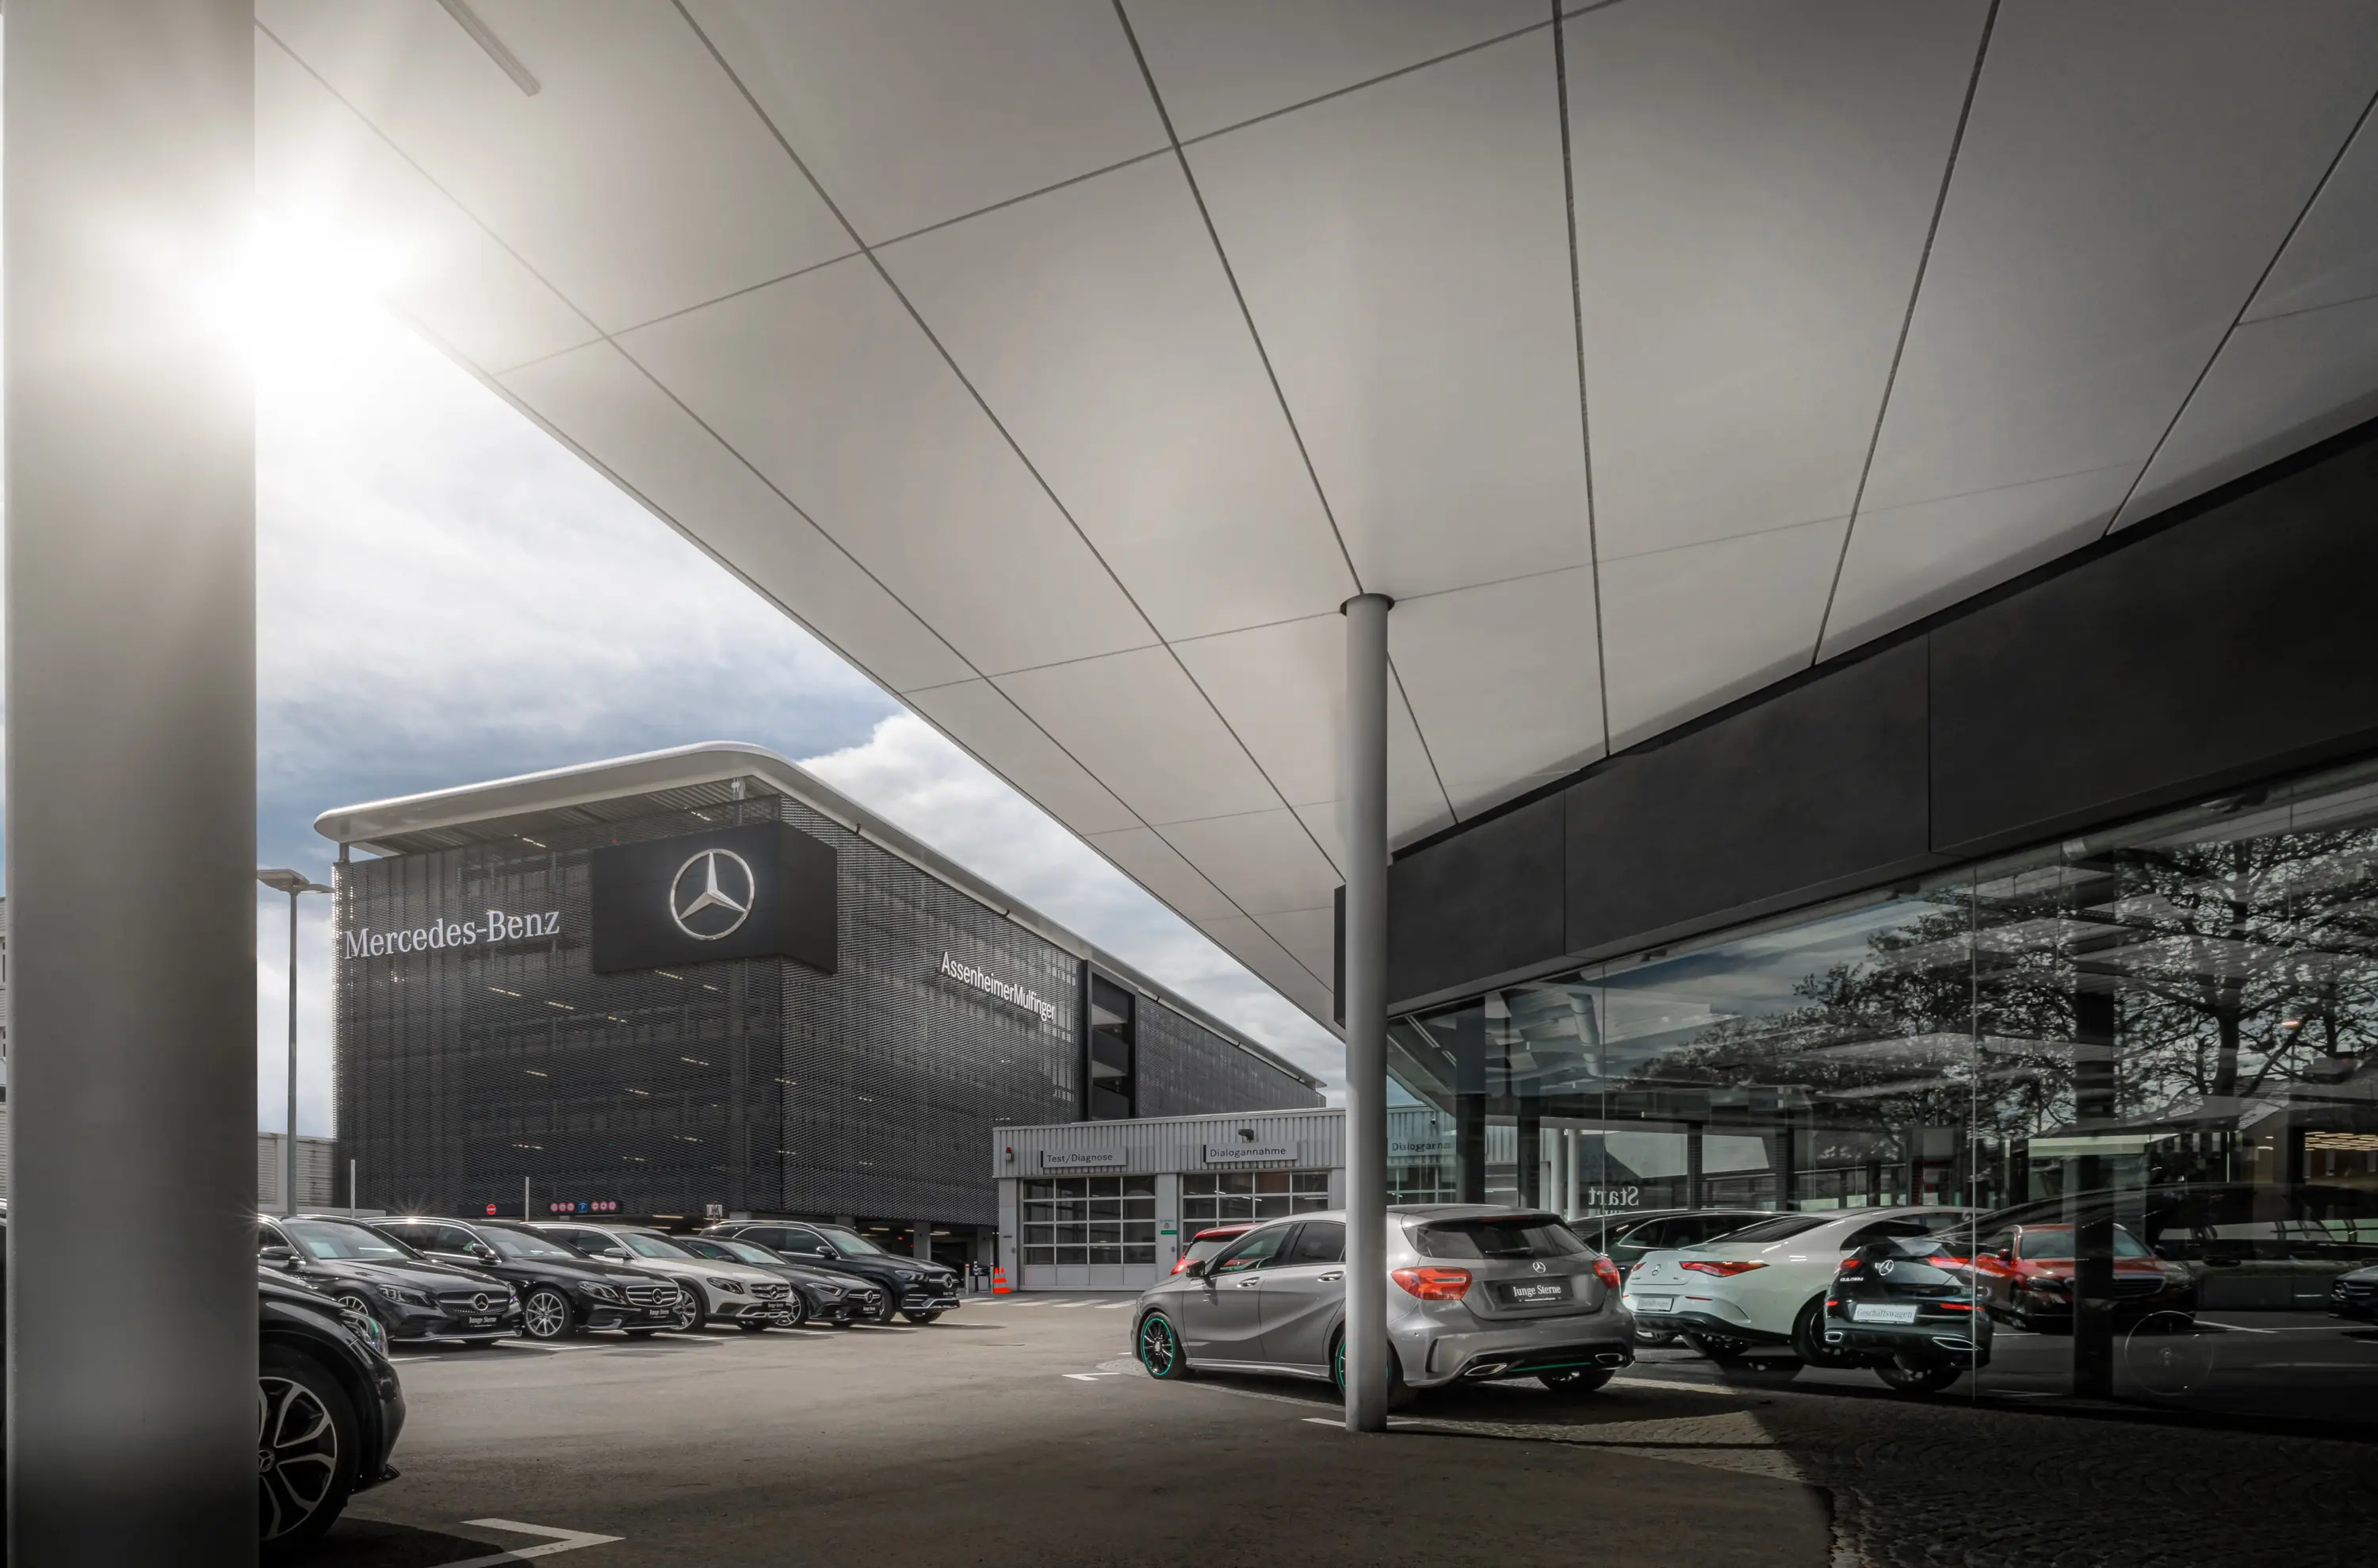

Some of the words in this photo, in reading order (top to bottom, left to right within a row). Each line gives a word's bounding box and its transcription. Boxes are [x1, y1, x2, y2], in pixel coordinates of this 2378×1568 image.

[344, 910, 560, 959] Mercedes-Benz
[942, 951, 1055, 1021] AssenheimerMulfinger
[1047, 1153, 1113, 1164] Test/Diagnose
[1210, 1148, 1286, 1158] Dialogannahme
[1512, 1286, 1536, 1297] Junge
[1537, 1284, 1562, 1295] Sterne
[1857, 1308, 1913, 1318] Geschäftswagen
